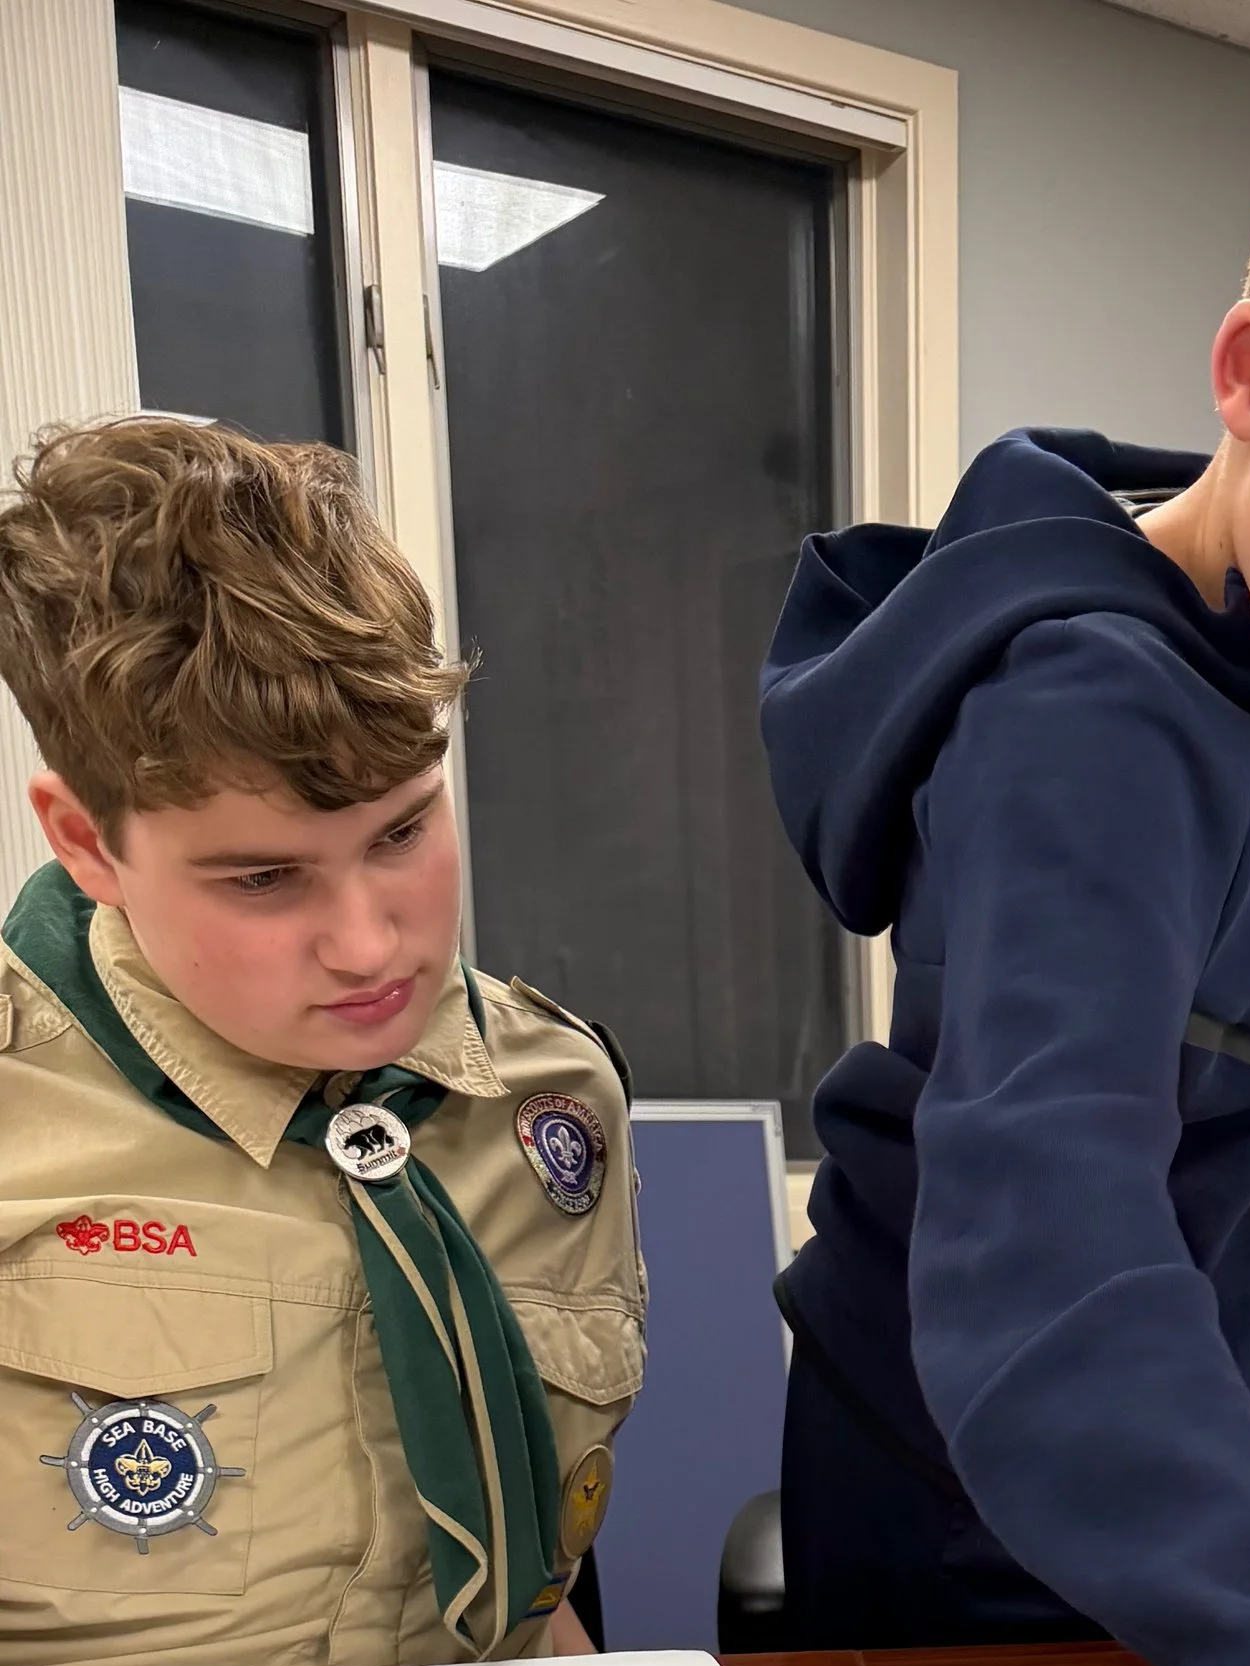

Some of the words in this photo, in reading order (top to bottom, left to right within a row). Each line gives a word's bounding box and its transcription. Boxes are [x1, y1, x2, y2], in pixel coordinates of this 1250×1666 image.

[356, 1149, 398, 1172] Summit
[113, 1220, 197, 1257] BSA
[102, 1421, 136, 1448] SEA
[143, 1420, 187, 1452] BASE
[93, 1468, 120, 1502] HIGH
[119, 1473, 194, 1514] ADVENTURE
